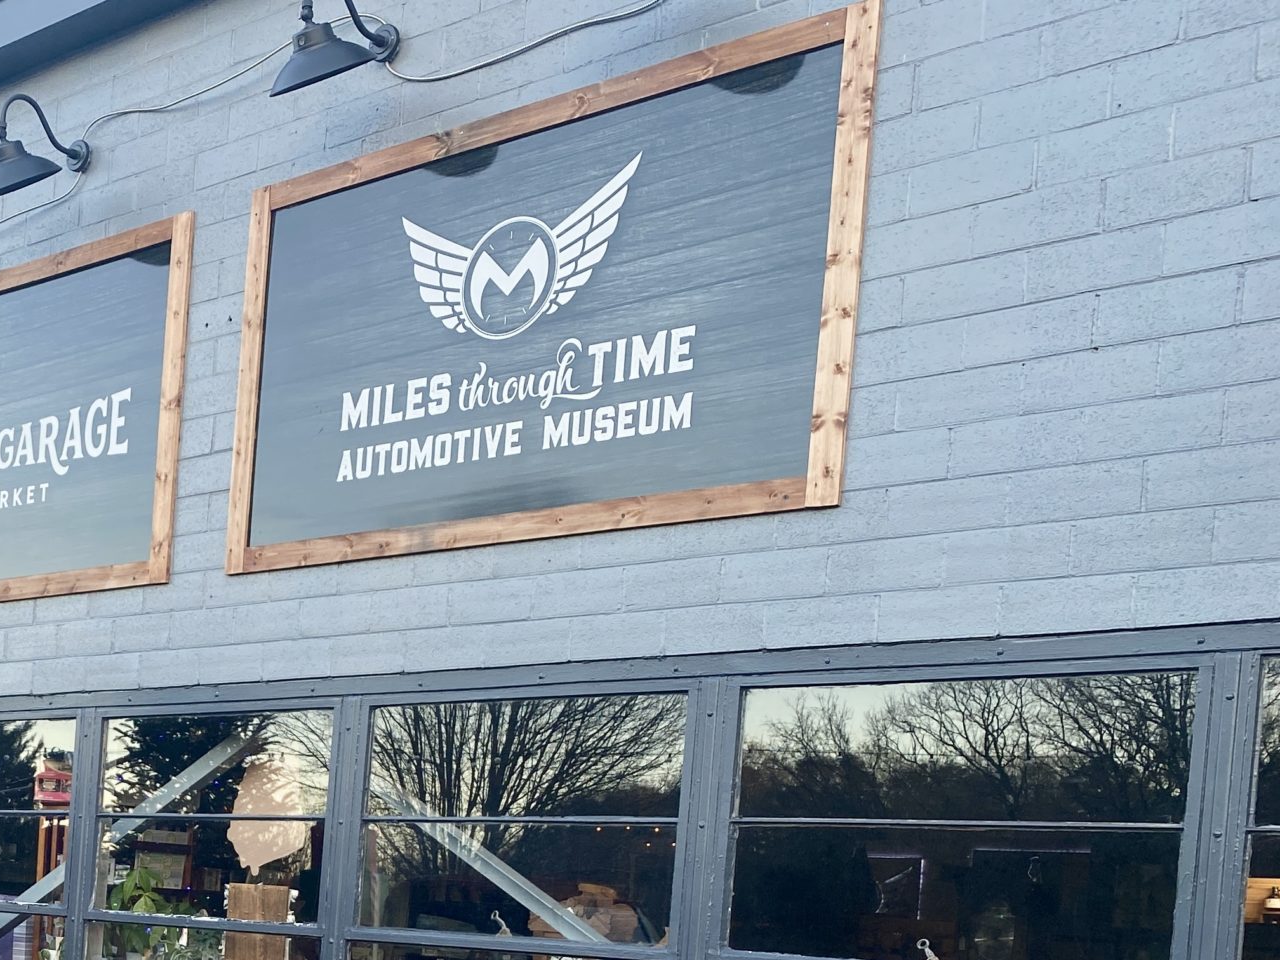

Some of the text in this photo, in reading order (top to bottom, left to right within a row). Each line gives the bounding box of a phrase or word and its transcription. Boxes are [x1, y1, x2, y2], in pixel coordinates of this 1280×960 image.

[339, 324, 697, 432] MILES through TIME
[336, 391, 694, 482] AUTOMOTIVE MUSEUM
